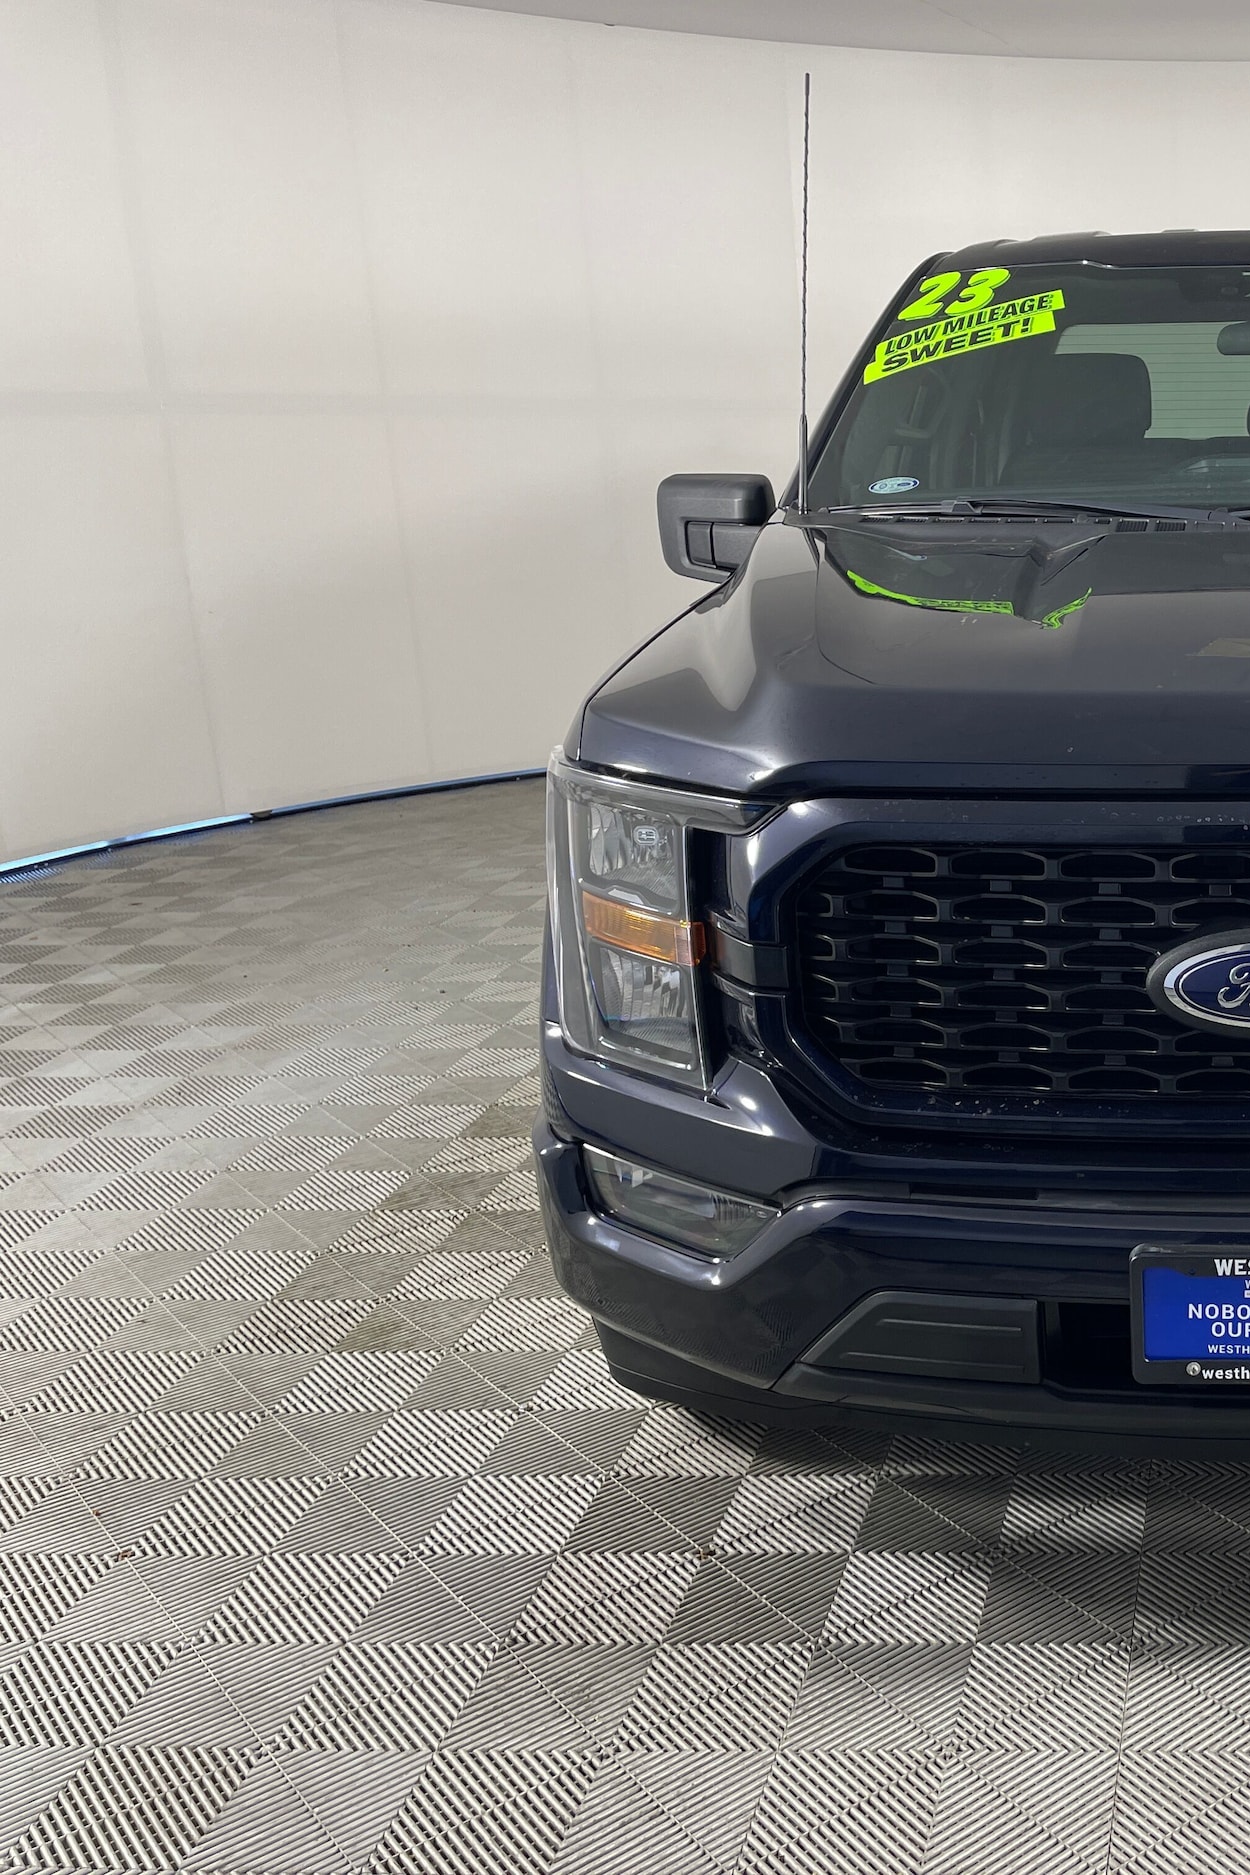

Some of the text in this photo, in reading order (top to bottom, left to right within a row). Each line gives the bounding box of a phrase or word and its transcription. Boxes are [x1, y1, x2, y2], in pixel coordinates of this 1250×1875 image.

[898, 268, 1010, 321] 23
[881, 317, 1033, 373] SWEET!
[884, 294, 1054, 355] LOW MILEAGE
